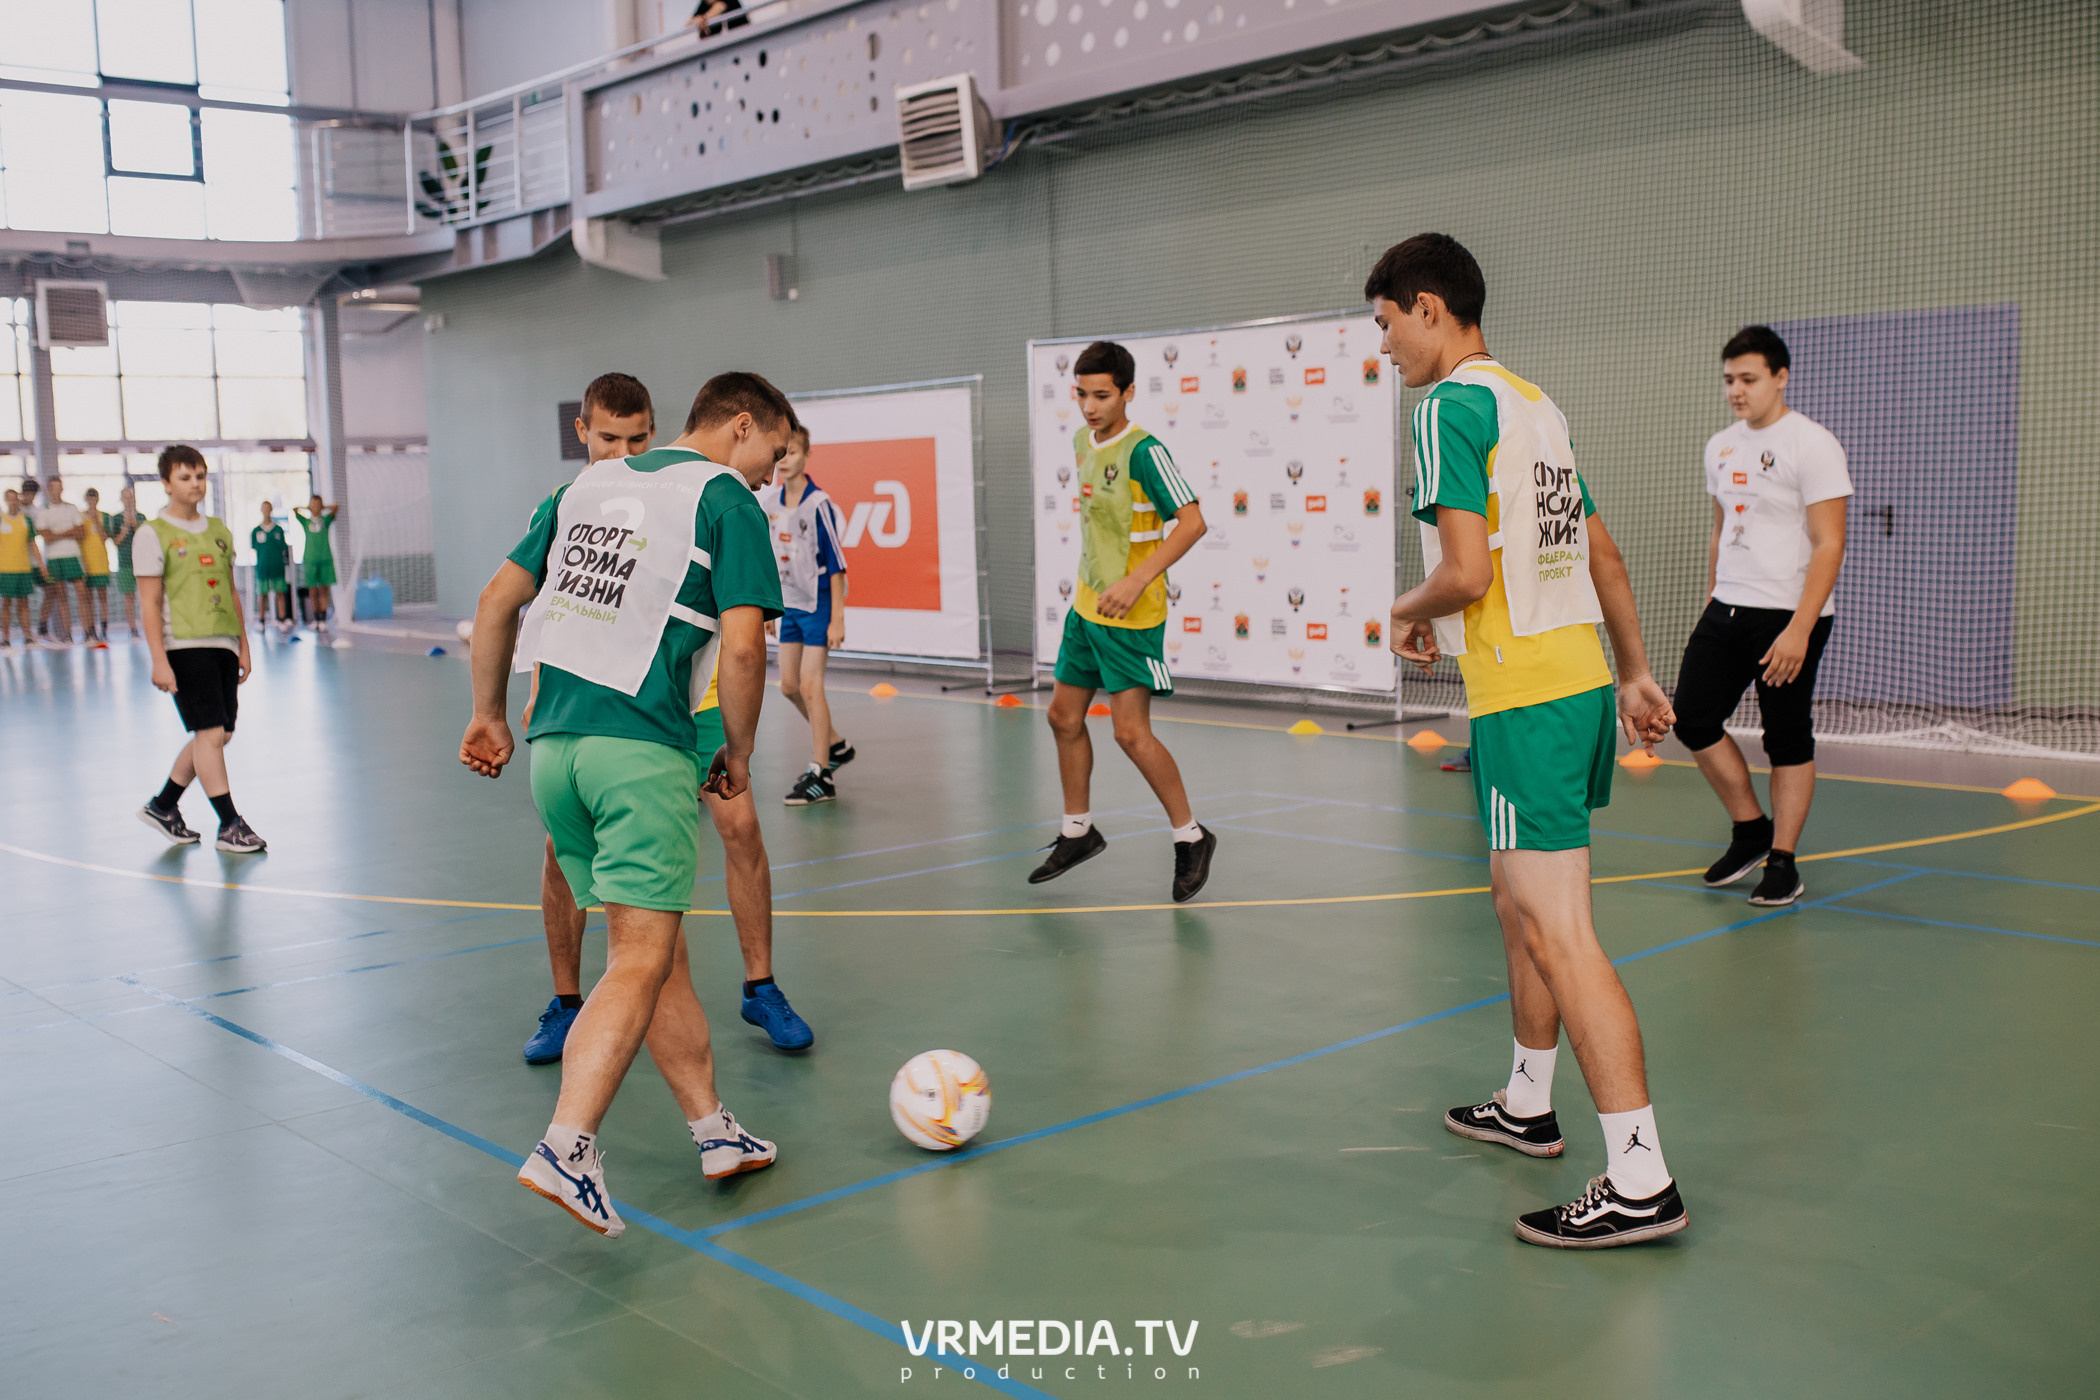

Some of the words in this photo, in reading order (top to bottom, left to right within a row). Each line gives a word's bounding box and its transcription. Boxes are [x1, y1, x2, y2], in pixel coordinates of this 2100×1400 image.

[559, 545, 637, 581] ОРМА
[1537, 550, 1586, 566] ФЕДЕРАЛ
[554, 569, 627, 609] ИЗНИ
[1538, 566, 1573, 584] ПРОЕКТ
[550, 596, 618, 625] ЕРАЛЬНЫЙ
